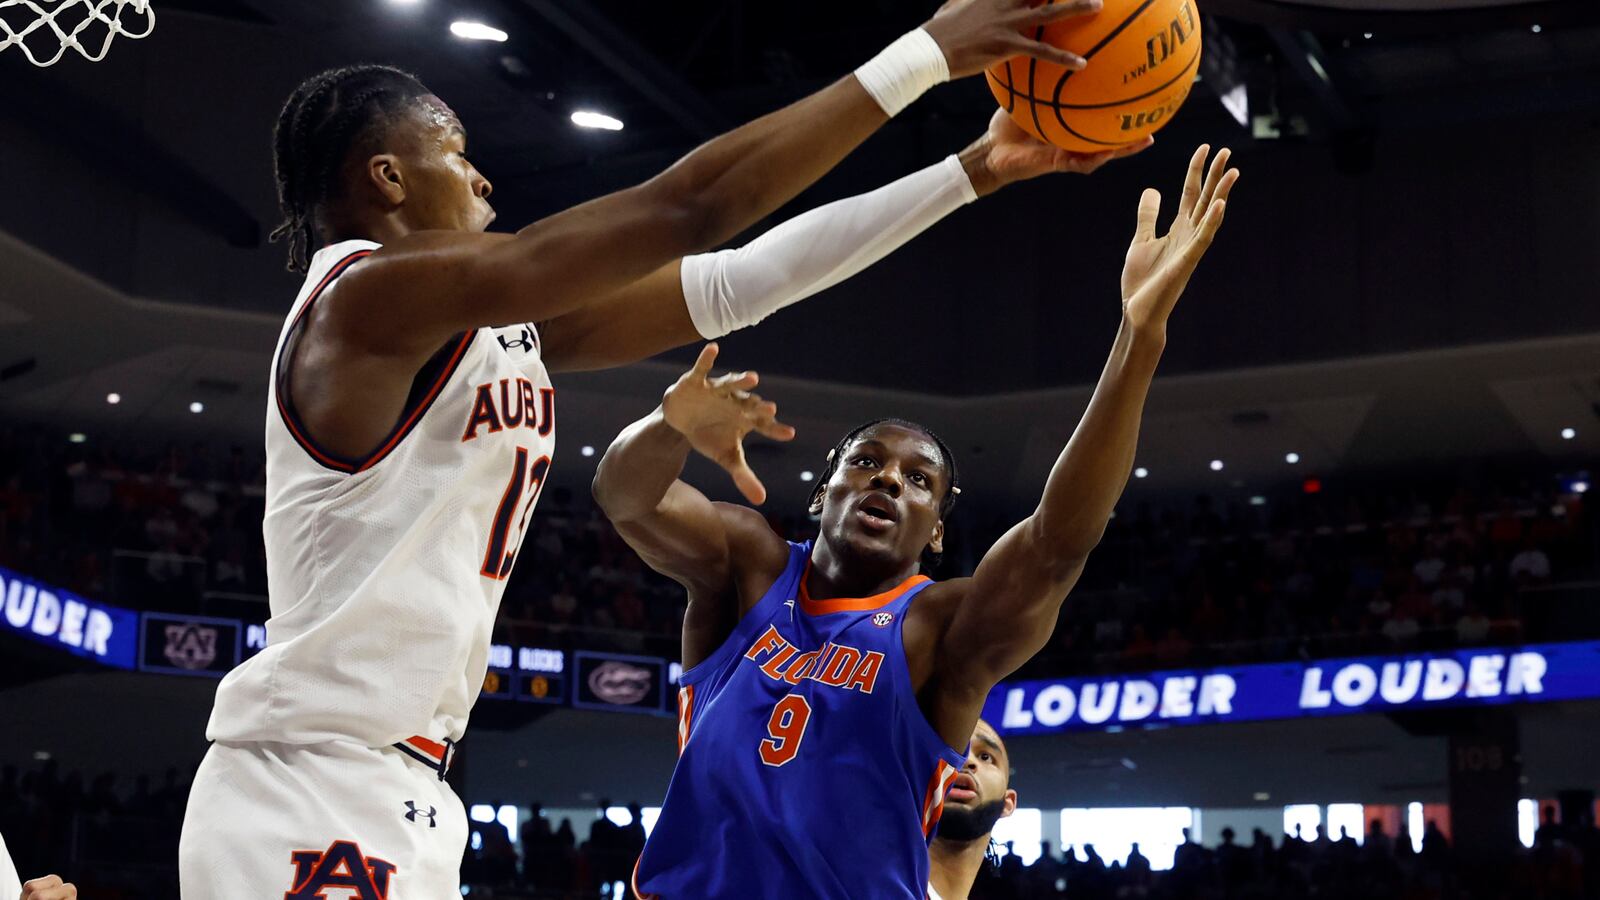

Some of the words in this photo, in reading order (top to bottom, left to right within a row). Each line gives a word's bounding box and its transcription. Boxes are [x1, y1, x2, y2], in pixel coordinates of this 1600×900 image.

[1146, 3, 1196, 69] EVO
[462, 377, 556, 442] AUB
[0, 574, 113, 656] UDER
[873, 612, 894, 626] SEC
[1002, 674, 1236, 728] LOUDER
[1299, 652, 1547, 708] LOUDER
[759, 694, 811, 767] 9
